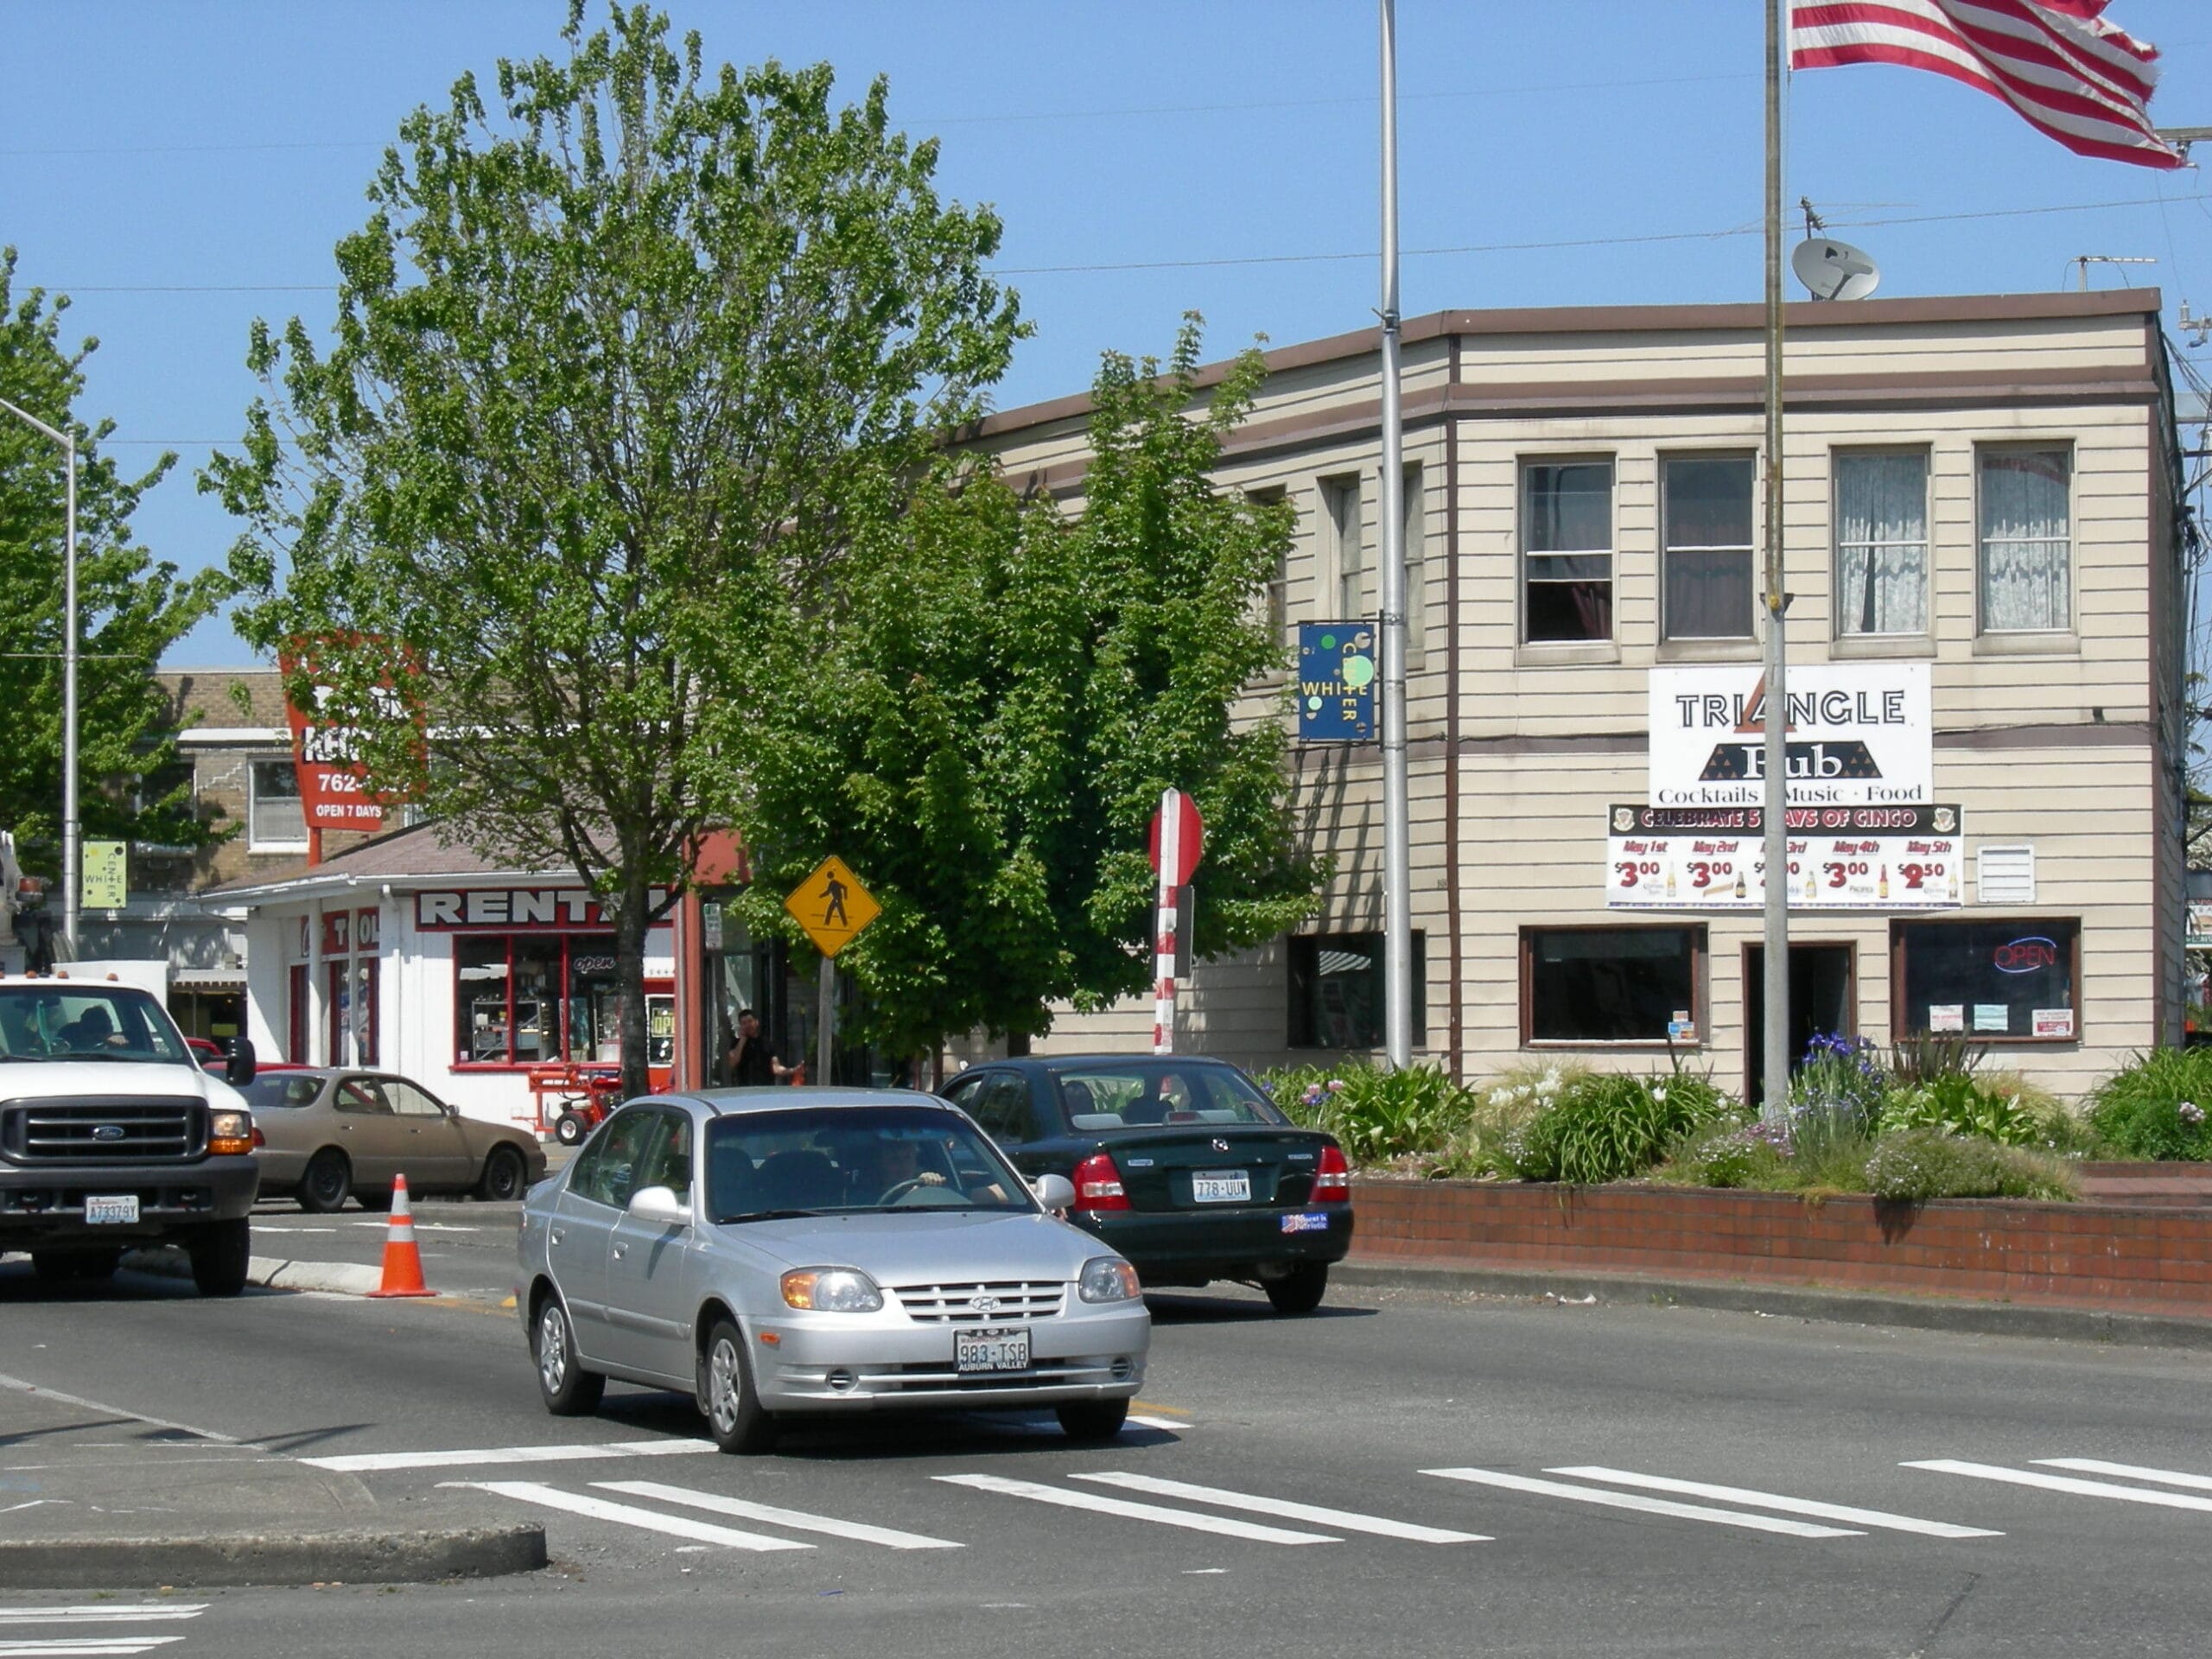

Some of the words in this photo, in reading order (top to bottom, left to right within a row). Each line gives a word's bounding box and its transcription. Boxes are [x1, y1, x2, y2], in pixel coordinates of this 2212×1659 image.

[1301, 681, 1368, 696] WHITE
[1658, 786, 1759, 804] Cocktails
[1866, 784, 1923, 802] Food
[315, 804, 345, 817] OPEN
[346, 804, 353, 817] 7
[355, 804, 383, 818] DAYS
[1640, 807, 1744, 828] CELEBRATE
[1747, 808, 1762, 828] 5
[1785, 808, 1818, 828] AYS
[1821, 808, 1850, 828] OF
[1853, 807, 1917, 828] CINCO
[1624, 840, 1648, 856] May
[1650, 840, 1669, 853] 1st
[1692, 840, 1715, 856] May
[1716, 840, 1739, 854] 2nd
[1833, 840, 1858, 856] May
[1859, 840, 1880, 854] 4th
[1906, 840, 1931, 856] May
[1931, 840, 1952, 854] 5th
[85, 874, 123, 884] WHITE
[107, 852, 117, 898] CENTER
[1994, 944, 2056, 966] OPEN
[573, 956, 617, 975] open
[958, 1362, 995, 1371] AUBURN
[996, 1359, 1028, 1370] VALLEY
